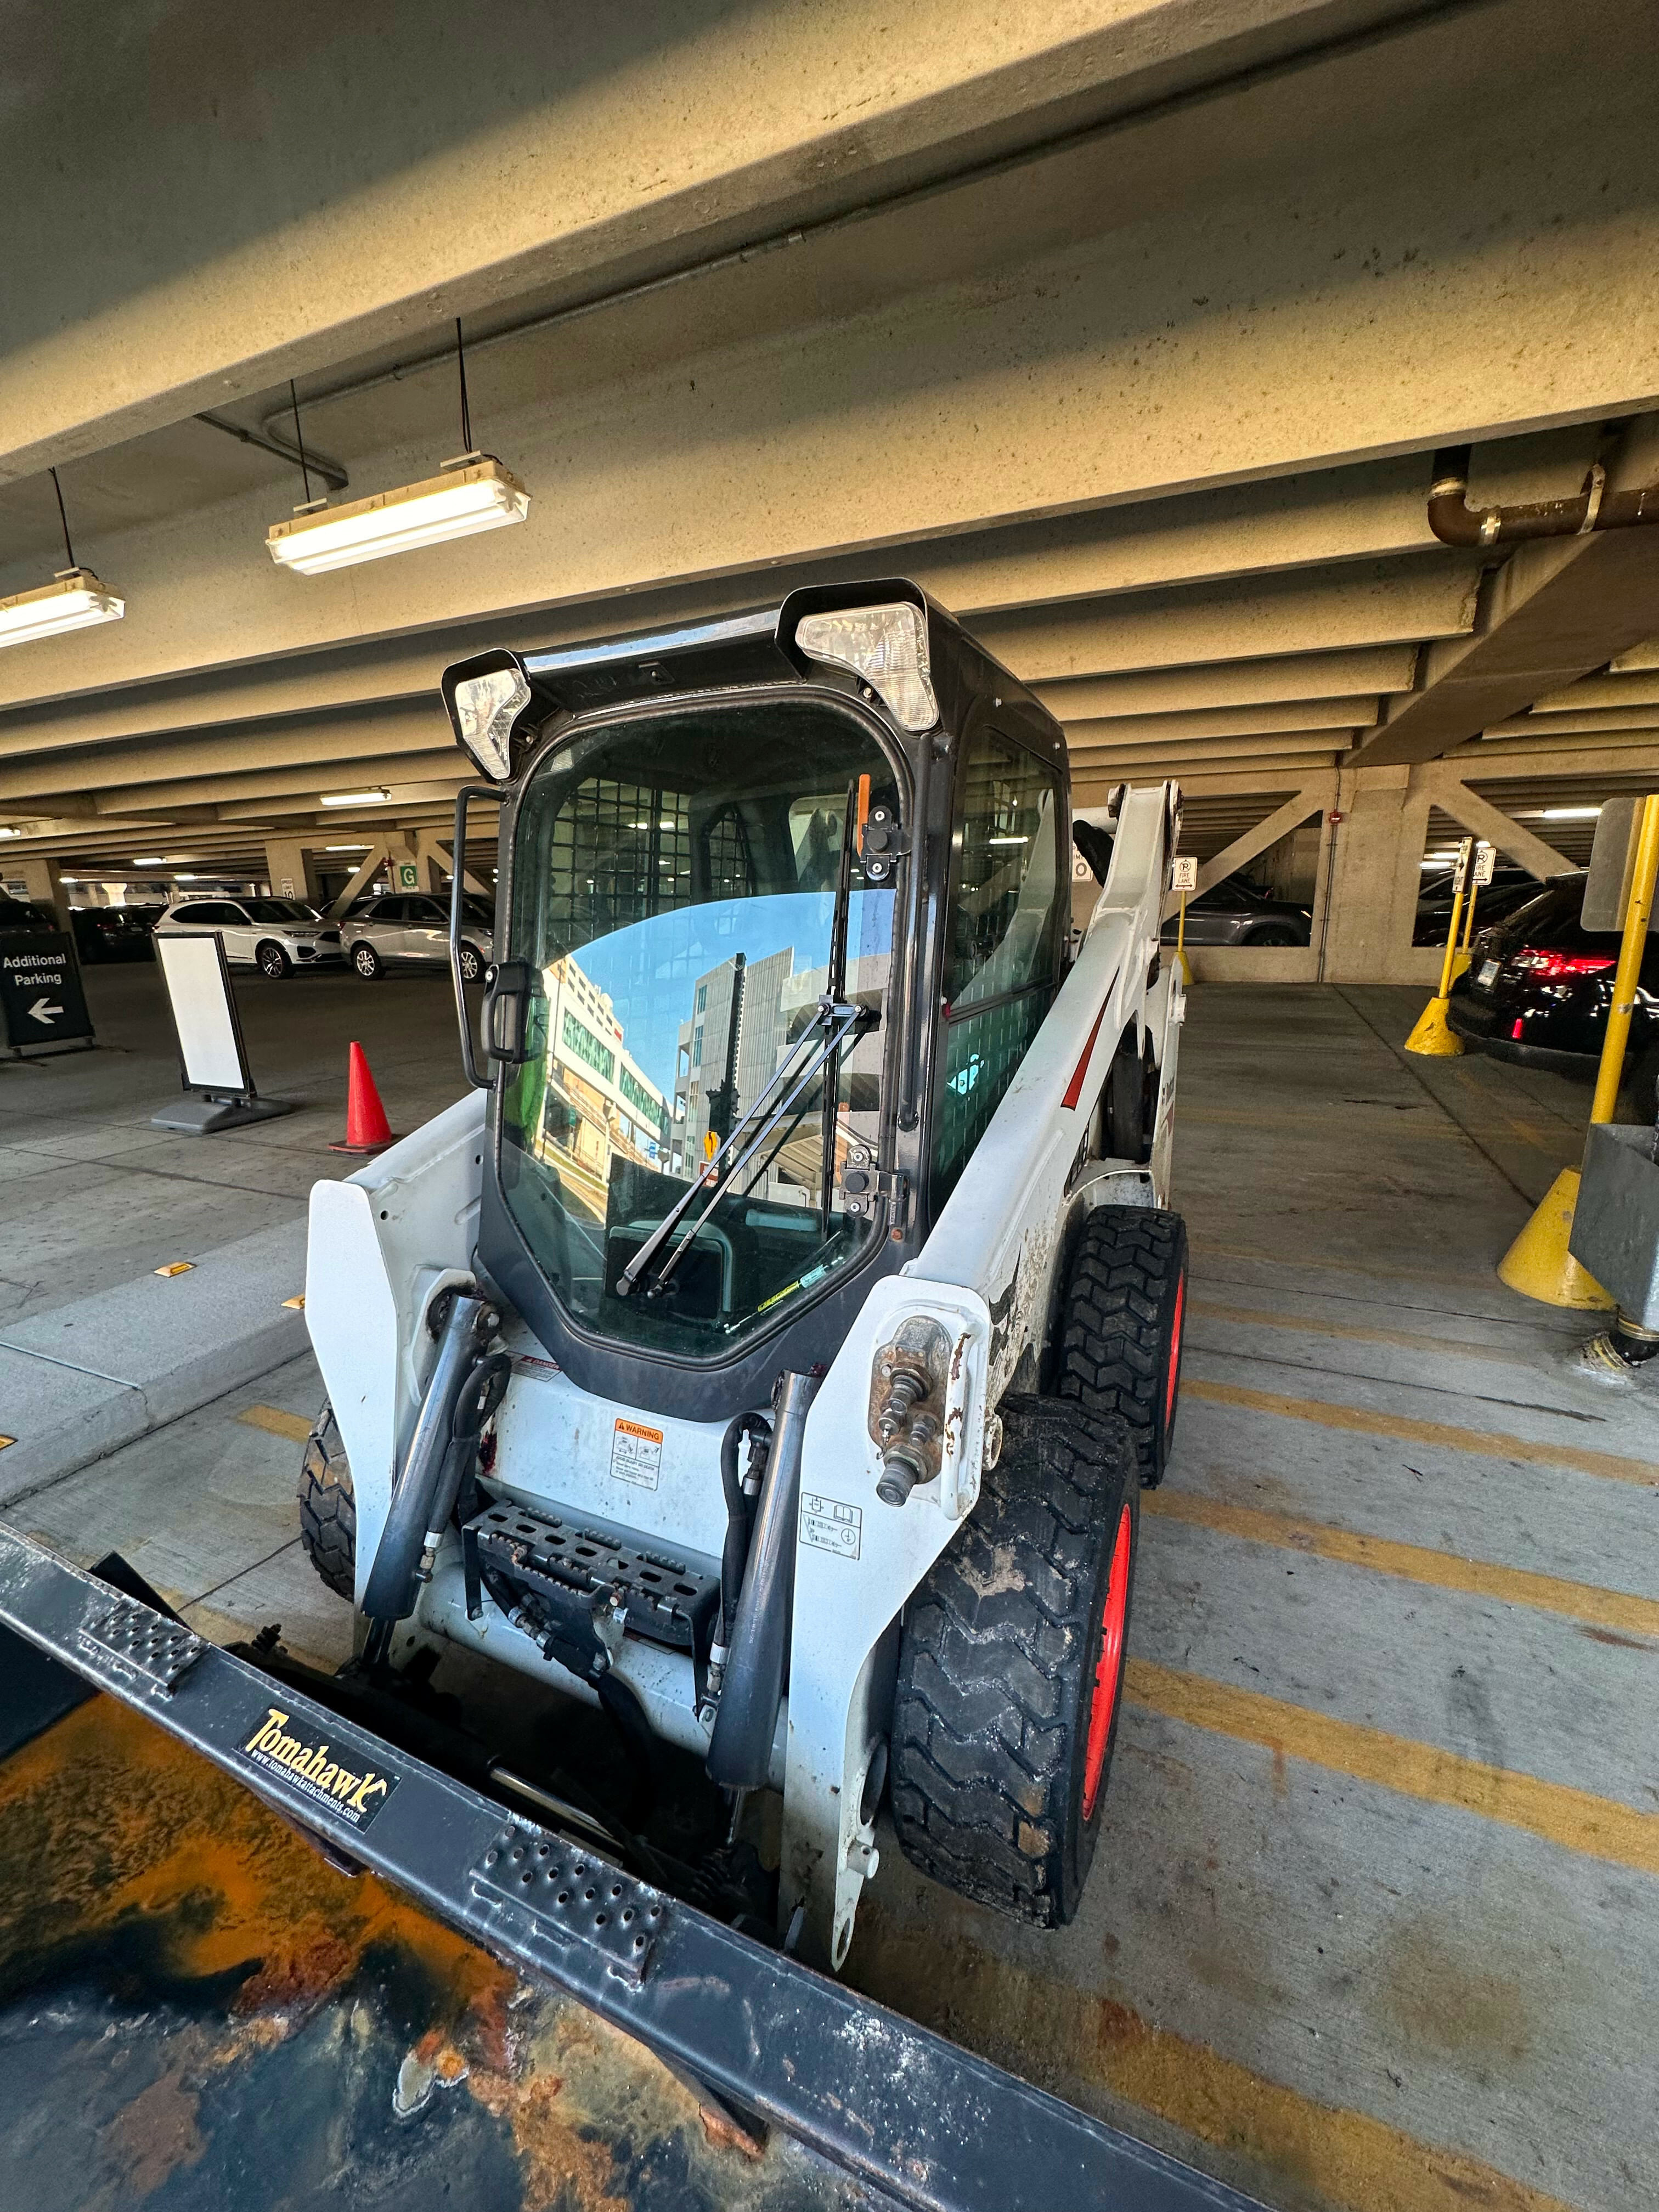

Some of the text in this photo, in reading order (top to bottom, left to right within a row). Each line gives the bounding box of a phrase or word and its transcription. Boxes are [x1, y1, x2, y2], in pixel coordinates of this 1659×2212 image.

[403, 868, 415, 884] G
[3, 953, 66, 968] Additional
[14, 973, 62, 986] Parking
[625, 1424, 659, 1440] WARNING
[251, 1749, 361, 1823] www.tomahawkattachments.com
